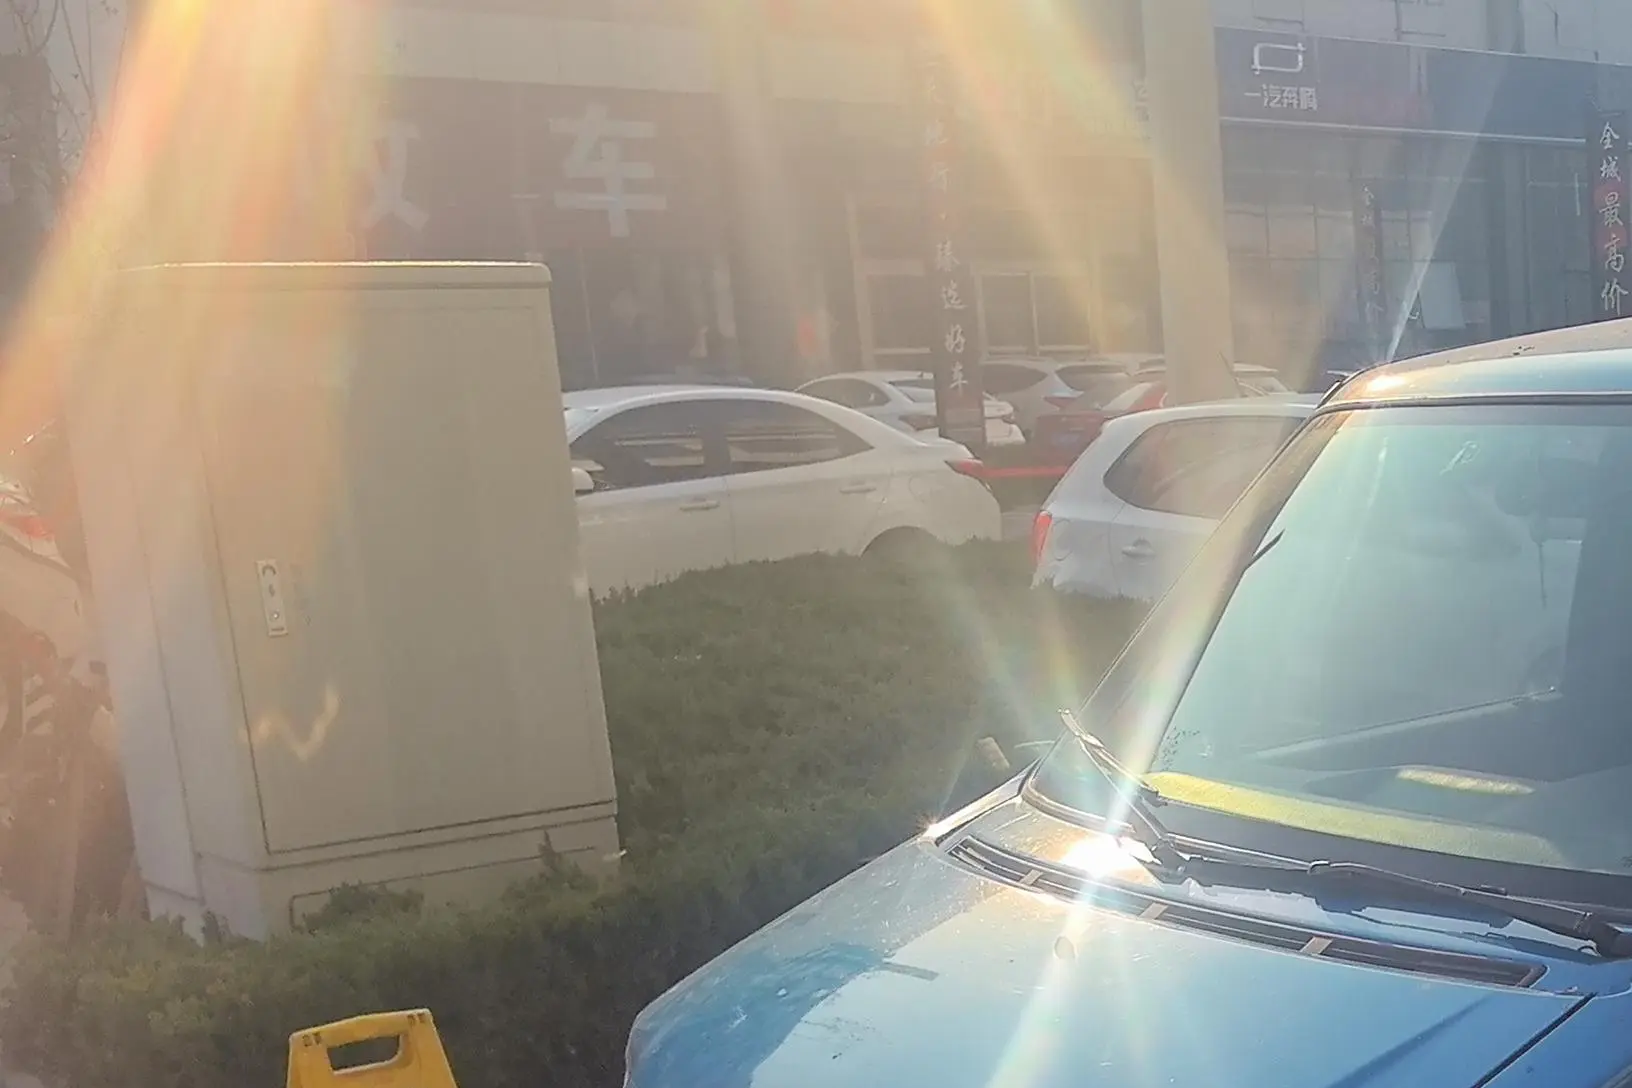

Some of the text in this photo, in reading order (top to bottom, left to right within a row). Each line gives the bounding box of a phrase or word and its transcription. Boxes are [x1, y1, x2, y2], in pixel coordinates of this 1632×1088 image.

[1244, 84, 1319, 111] 一汽奔腾
[1598, 121, 1630, 316] 全城最高价
